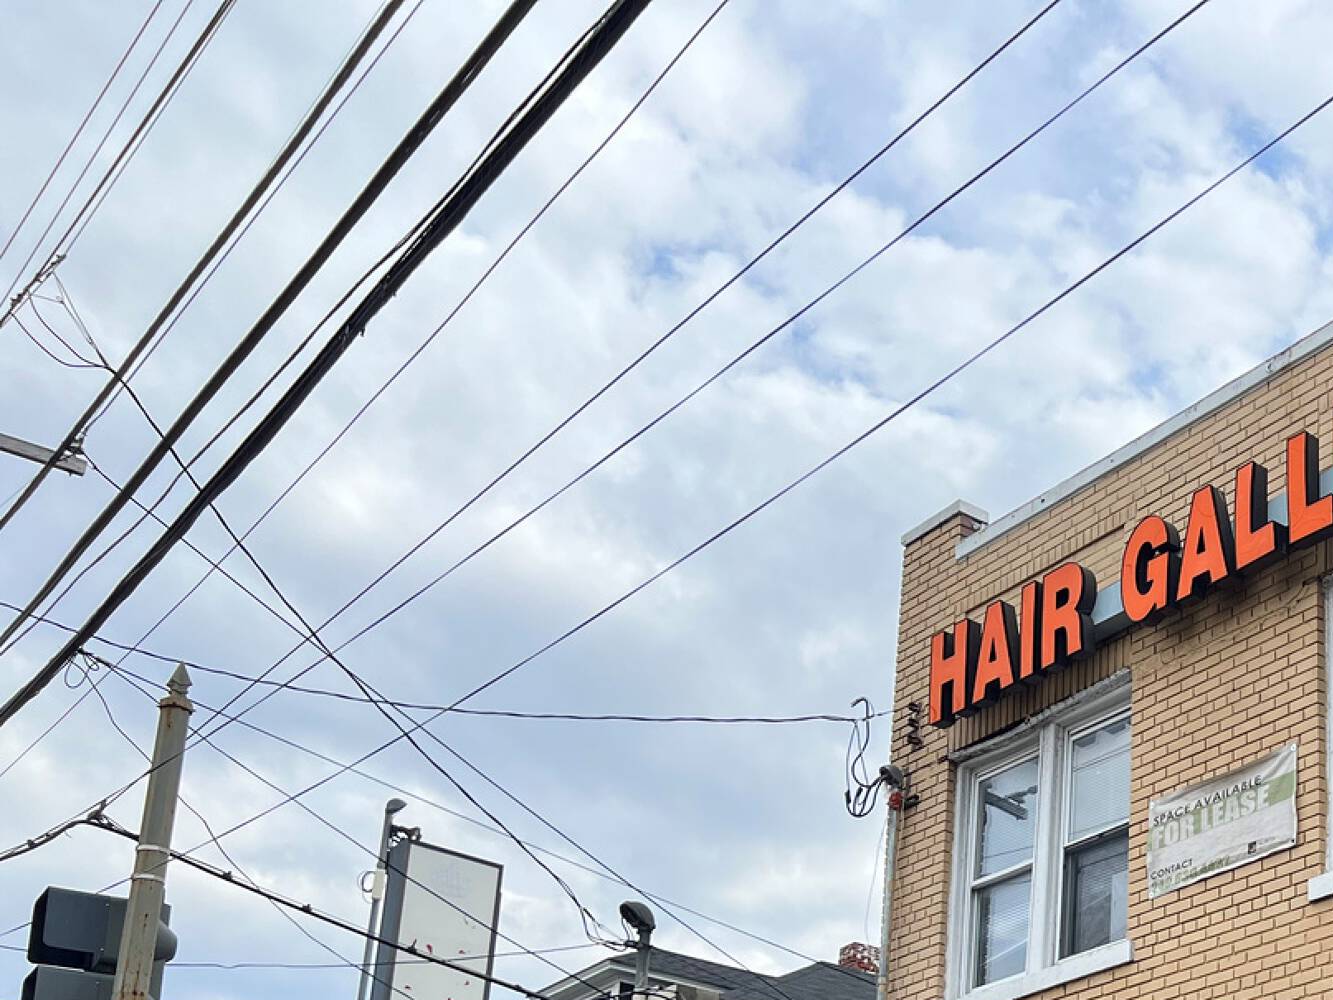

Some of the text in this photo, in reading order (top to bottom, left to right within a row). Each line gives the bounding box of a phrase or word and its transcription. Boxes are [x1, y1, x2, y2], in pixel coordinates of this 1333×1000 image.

[929, 561, 1097, 727] HAIR
[1153, 774, 1263, 827] SPACE AVAILABLE
[1153, 784, 1270, 849] FOR LEASE
[1150, 858, 1193, 880] CONTACT
